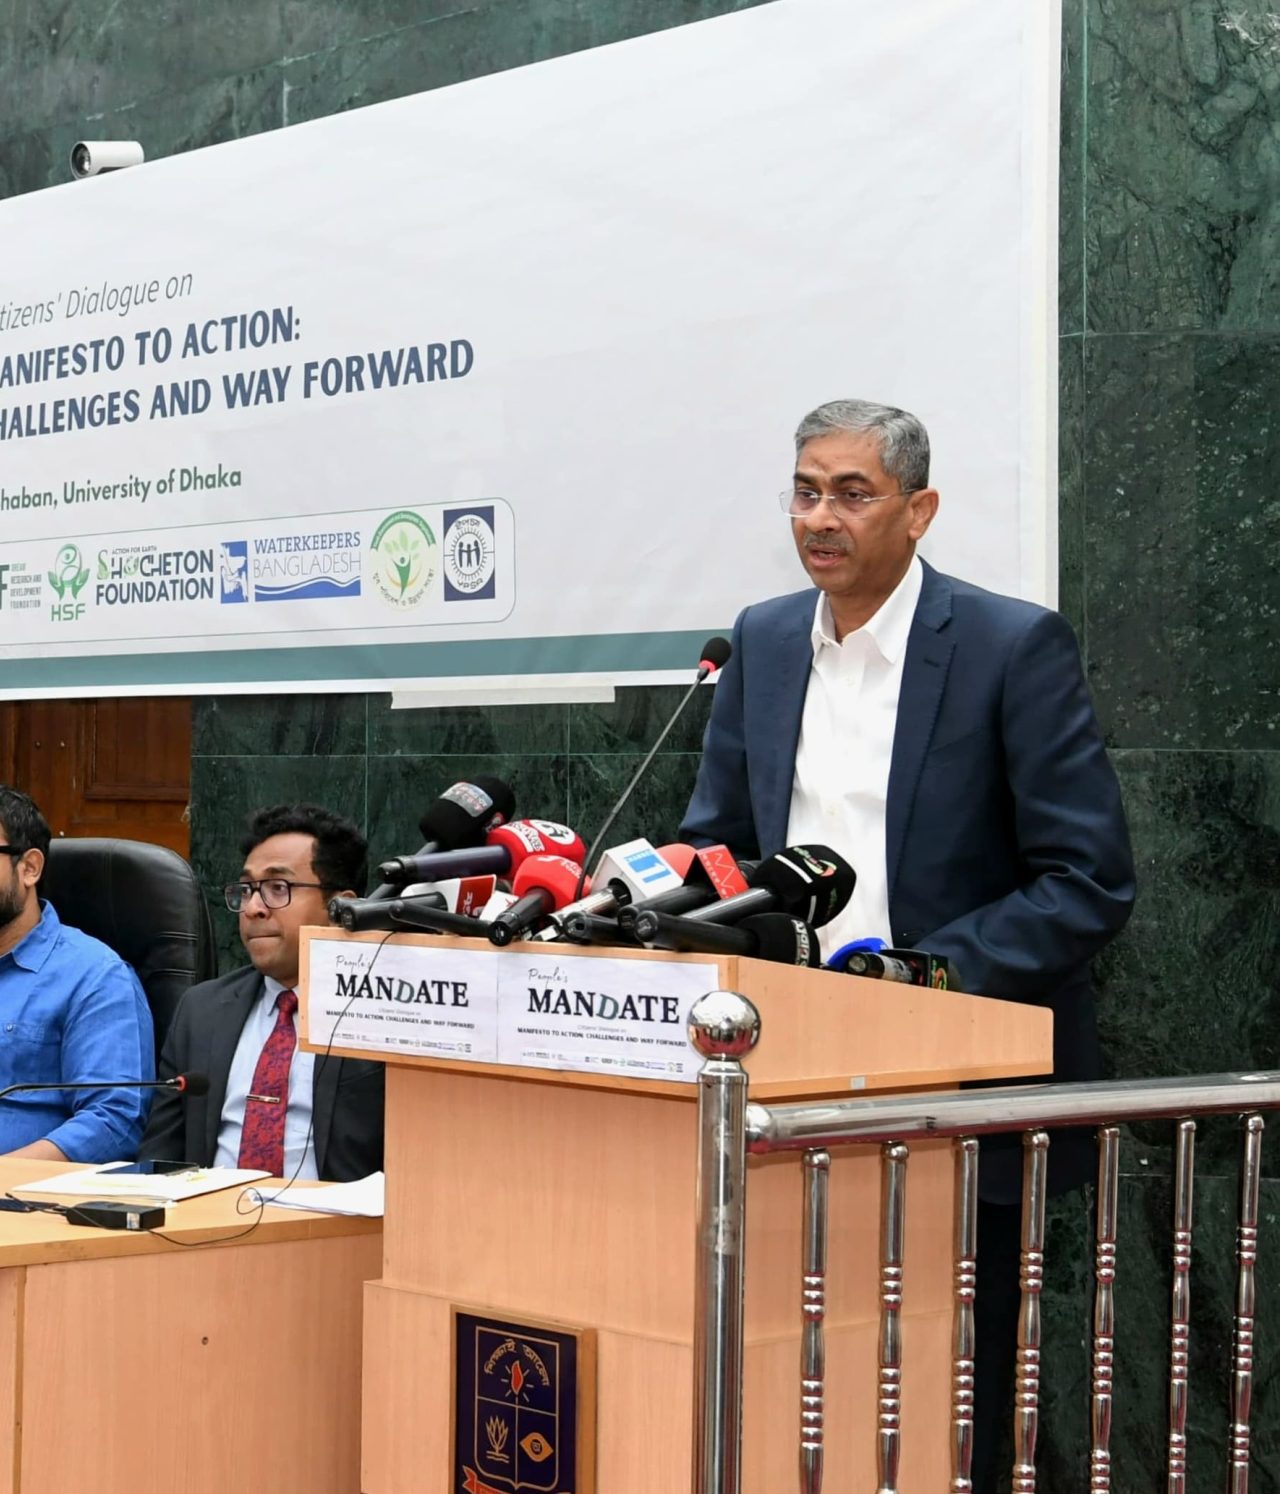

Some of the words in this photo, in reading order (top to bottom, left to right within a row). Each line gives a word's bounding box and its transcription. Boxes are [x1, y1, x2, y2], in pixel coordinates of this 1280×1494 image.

[66, 279, 160, 318] Dialogue
[165, 272, 193, 300] on
[135, 327, 173, 365] TO
[181, 305, 301, 359] ACTION:
[149, 378, 212, 420] AND
[222, 365, 292, 409] WAY
[303, 338, 474, 399] FORWARD
[63, 474, 152, 503] University
[156, 468, 176, 495] of
[179, 463, 242, 492] Dhaka
[254, 531, 361, 555] WATERKEEPERS
[253, 551, 361, 579] BANGLADESH
[96, 577, 214, 605] FOUNDATION
[457, 577, 483, 590] YPSA
[50, 603, 86, 622] HSF
[335, 973, 469, 1008] MANDATE
[527, 988, 680, 1024] MANDATE
